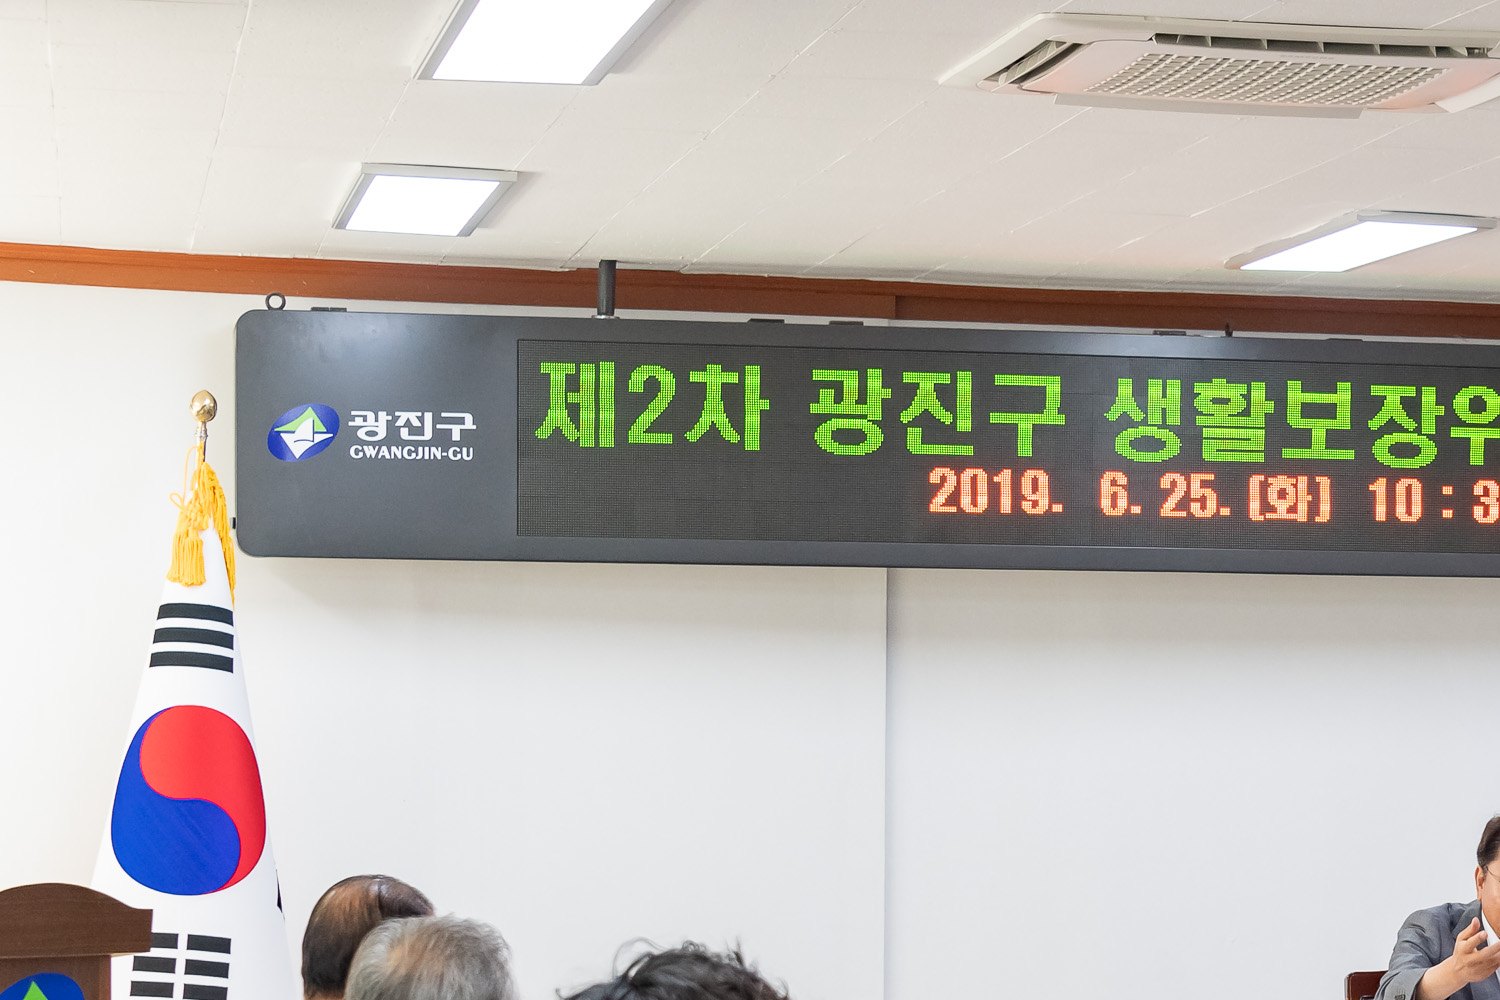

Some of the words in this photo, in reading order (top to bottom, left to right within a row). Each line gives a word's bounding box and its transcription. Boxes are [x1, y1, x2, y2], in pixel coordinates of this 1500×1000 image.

[348, 410, 477, 441] 광진구
[534, 360, 770, 451] 제2차
[809, 368, 1066, 456] 광진구
[349, 444, 474, 461] GWANGJIN-GU
[928, 466, 1064, 515] 2019.
[1099, 470, 1142, 517] 6.
[1159, 472, 1232, 519] 25.
